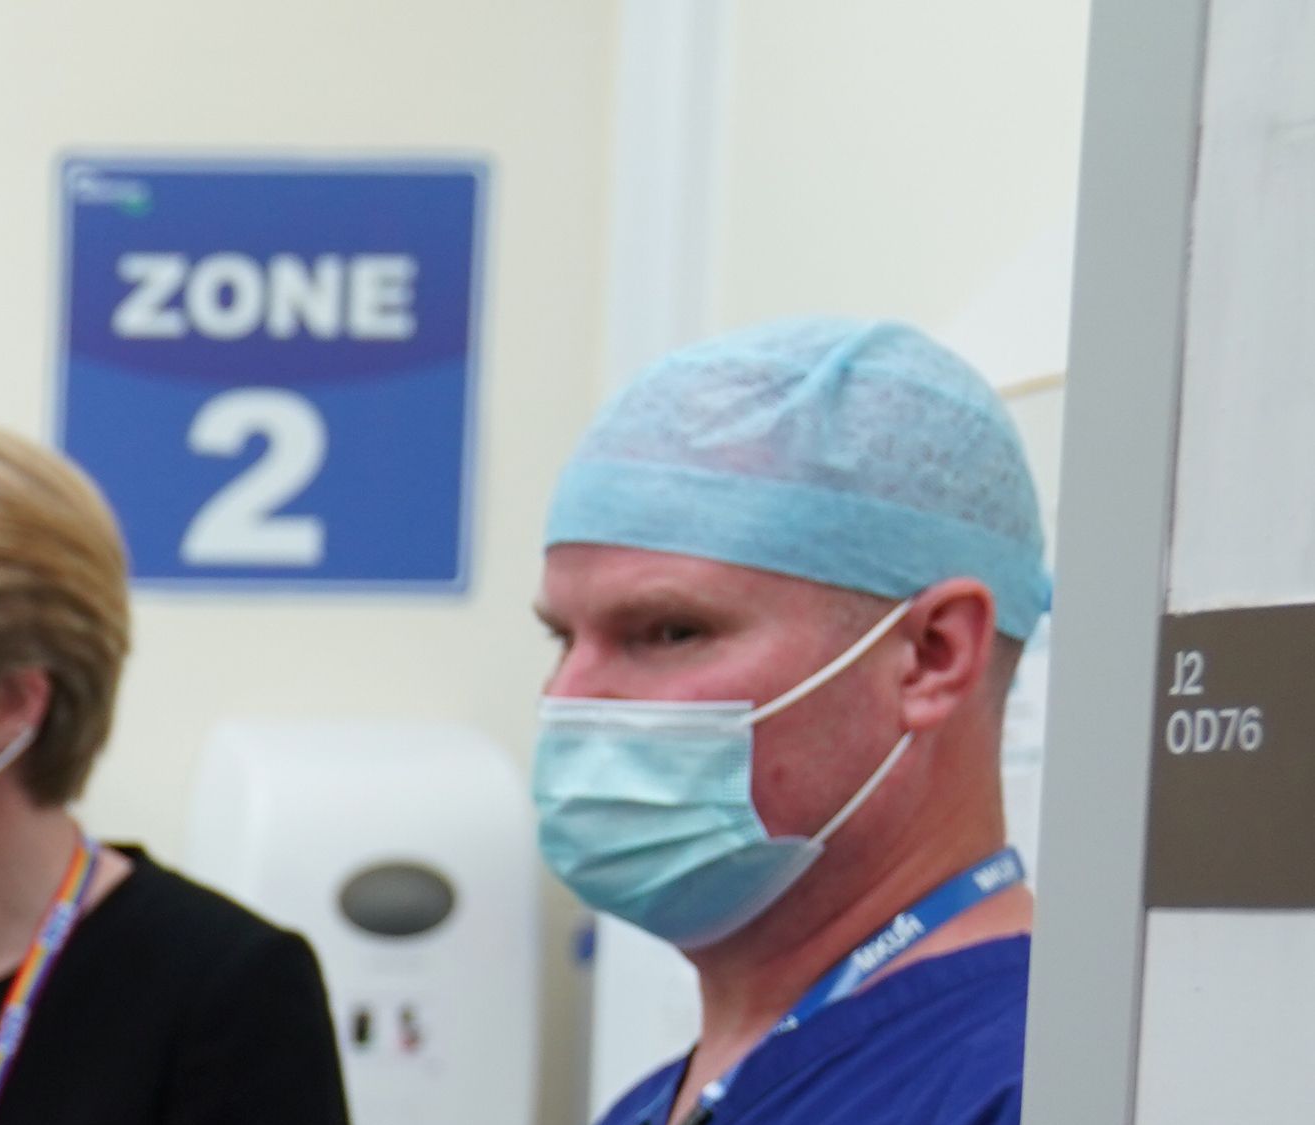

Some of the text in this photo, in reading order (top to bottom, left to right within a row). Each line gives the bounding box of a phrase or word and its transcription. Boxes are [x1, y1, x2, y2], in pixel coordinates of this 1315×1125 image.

[115, 254, 413, 338] ZONE
[181, 389, 327, 566] 2
[1168, 650, 1204, 696] J2
